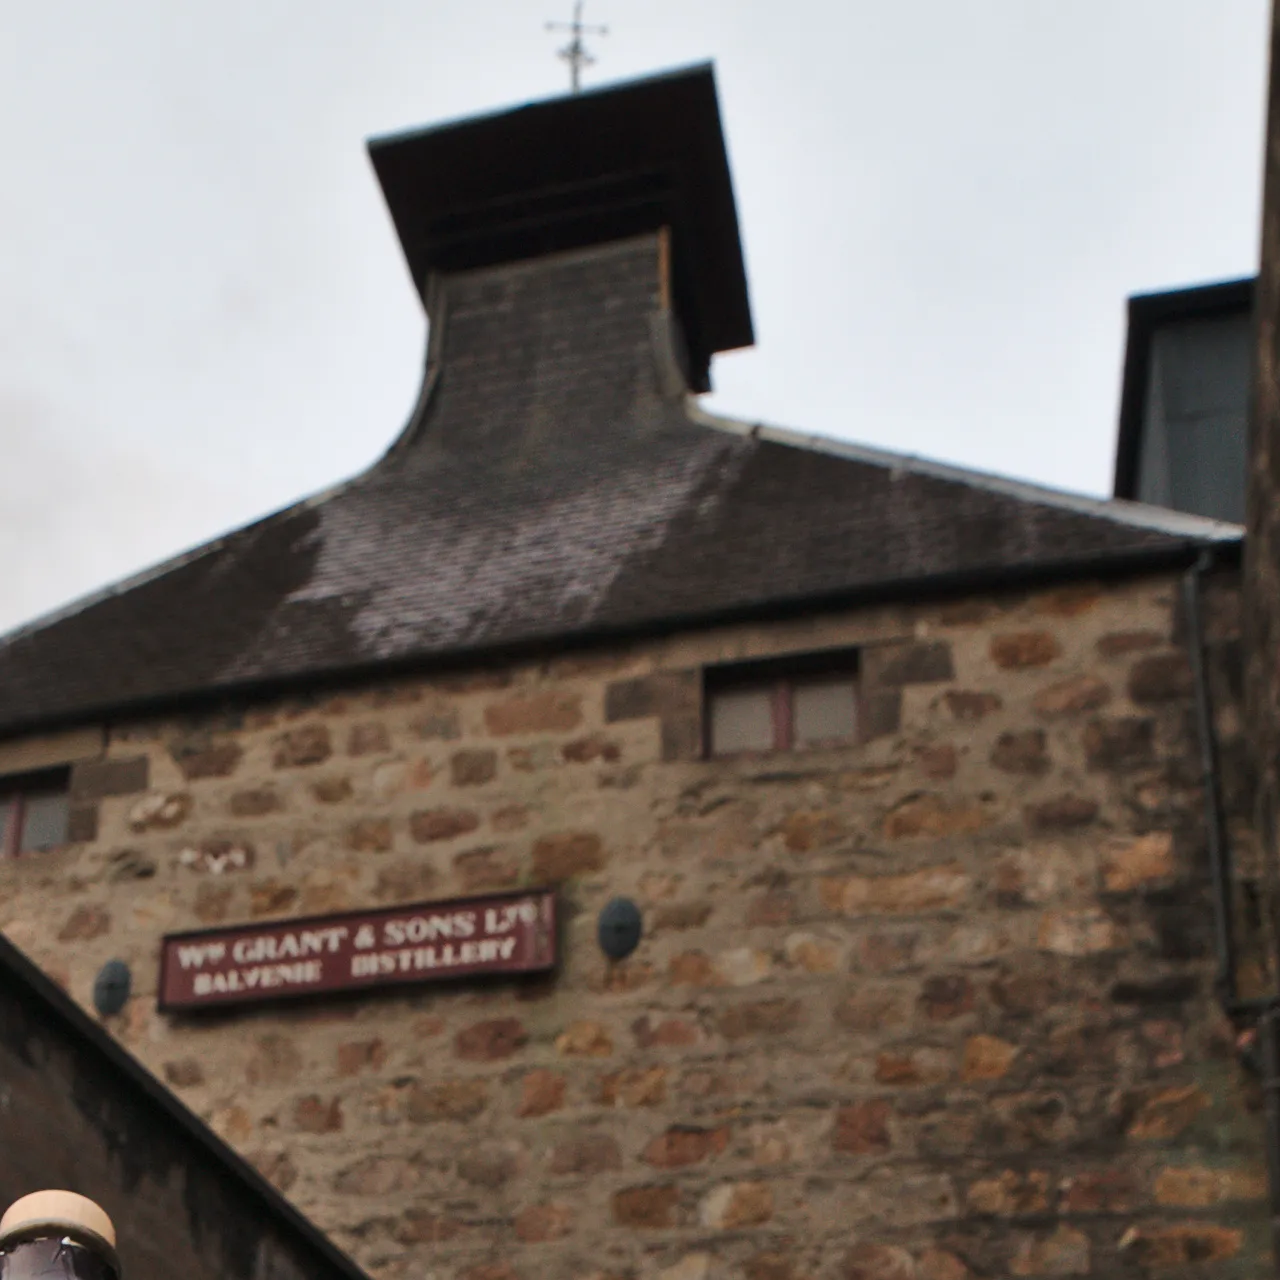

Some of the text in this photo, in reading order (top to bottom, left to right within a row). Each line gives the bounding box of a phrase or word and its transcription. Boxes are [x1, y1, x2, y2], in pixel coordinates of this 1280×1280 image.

[233, 926, 348, 963] GRANT
[354, 923, 375, 949] &
[384, 911, 476, 946] SONS
[194, 936, 516, 995] BALVENIE DISTILLERY
